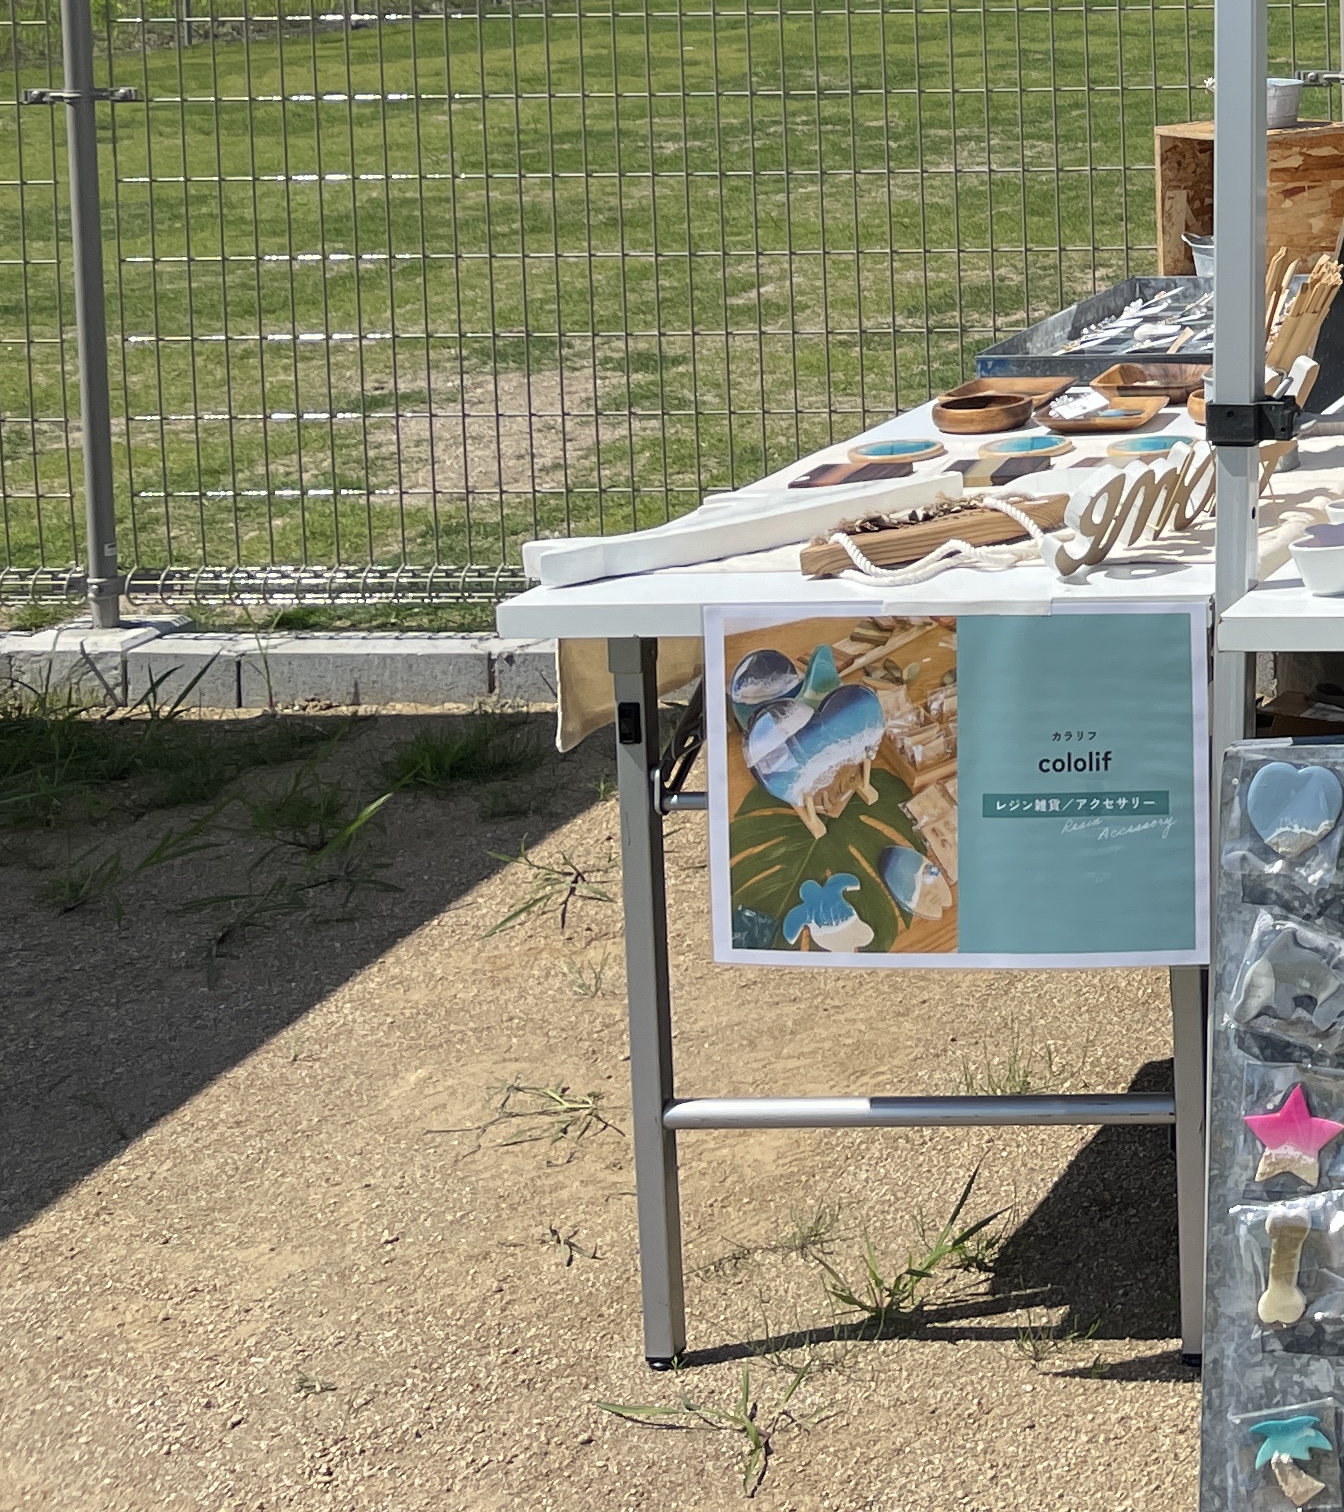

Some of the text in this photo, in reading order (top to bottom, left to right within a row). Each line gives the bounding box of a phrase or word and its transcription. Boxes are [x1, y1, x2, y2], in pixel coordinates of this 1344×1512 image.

[1051, 731, 1098, 742] カラリフ
[1038, 750, 1113, 773] cololif
[1096, 815, 1178, 841] Accessory
